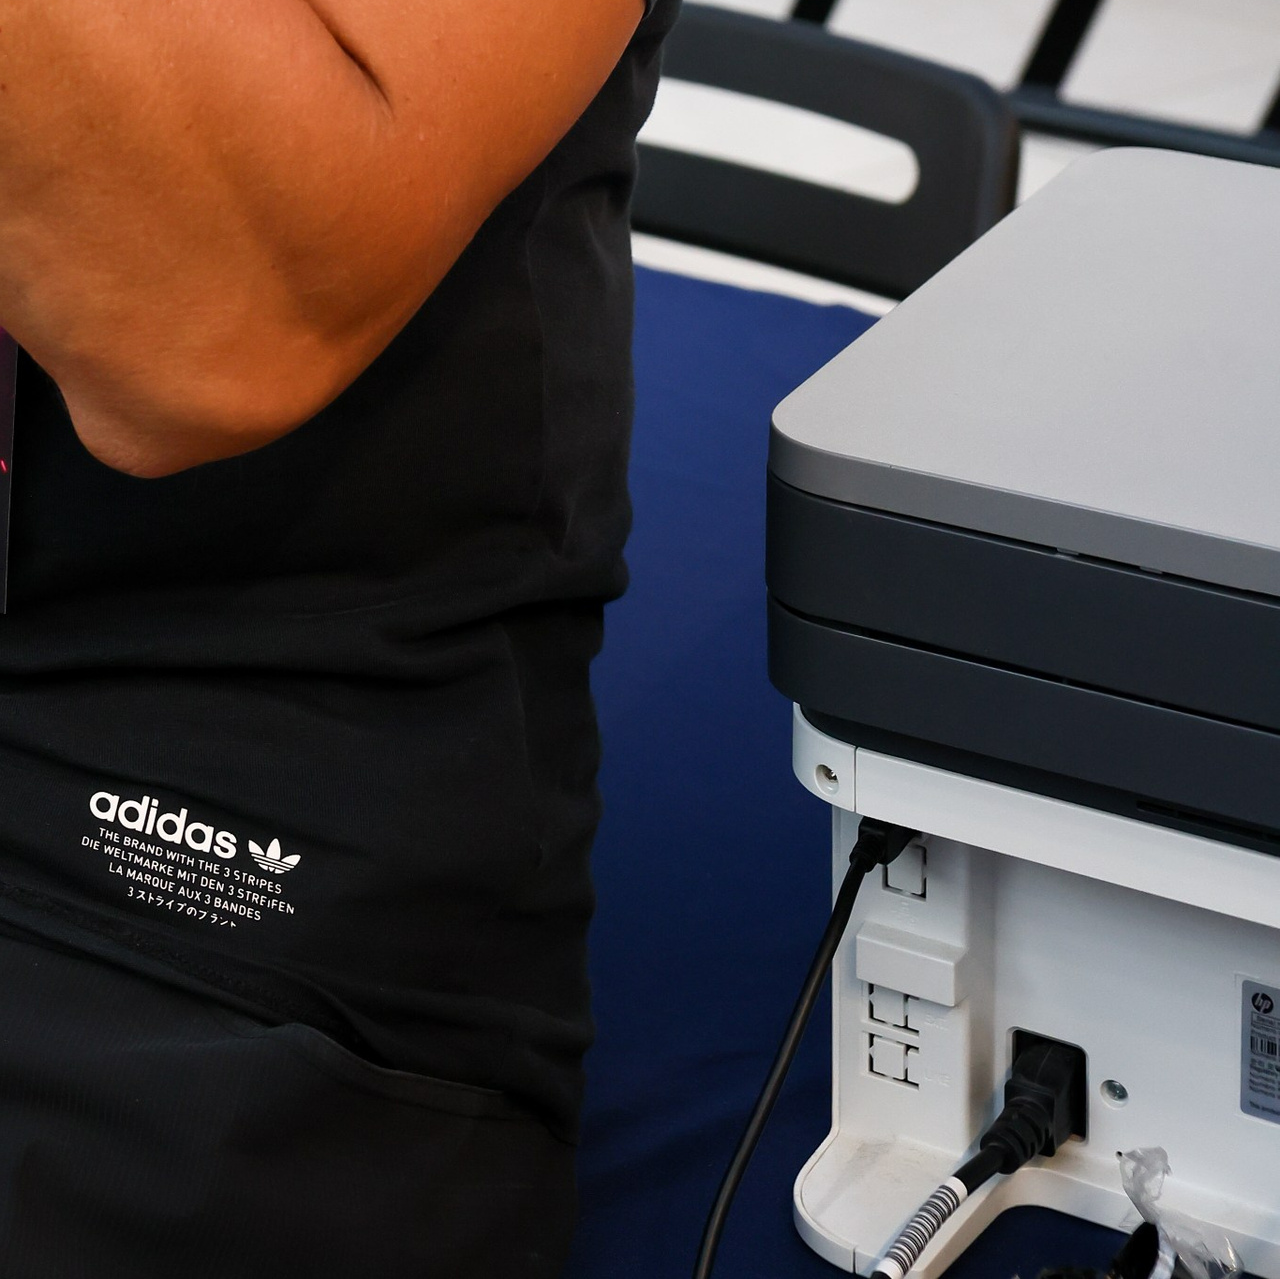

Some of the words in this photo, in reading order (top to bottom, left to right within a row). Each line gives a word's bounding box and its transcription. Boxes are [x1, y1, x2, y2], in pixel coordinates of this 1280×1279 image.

[89, 790, 238, 860] adidas
[81, 836, 101, 851] DIE
[103, 844, 175, 878] WELTMARKE
[176, 868, 198, 885] MIT
[200, 875, 225, 893] DEN
[227, 884, 235, 896] 3
[236, 888, 296, 915] STREIFEN
[98, 827, 121, 844] THE
[122, 836, 164, 858] BRAND
[165, 849, 195, 868] WITH
[197, 859, 221, 876] THE
[223, 866, 231, 878] 3
[232, 869, 283, 895] STRIPES
[108, 861, 124, 877] LA
[125, 868, 176, 893] MARQUE
[177, 885, 202, 902] AUX
[203, 894, 212, 905] 3
[213, 896, 262, 922] BANDES
[1252, 993, 1273, 1015] hp
